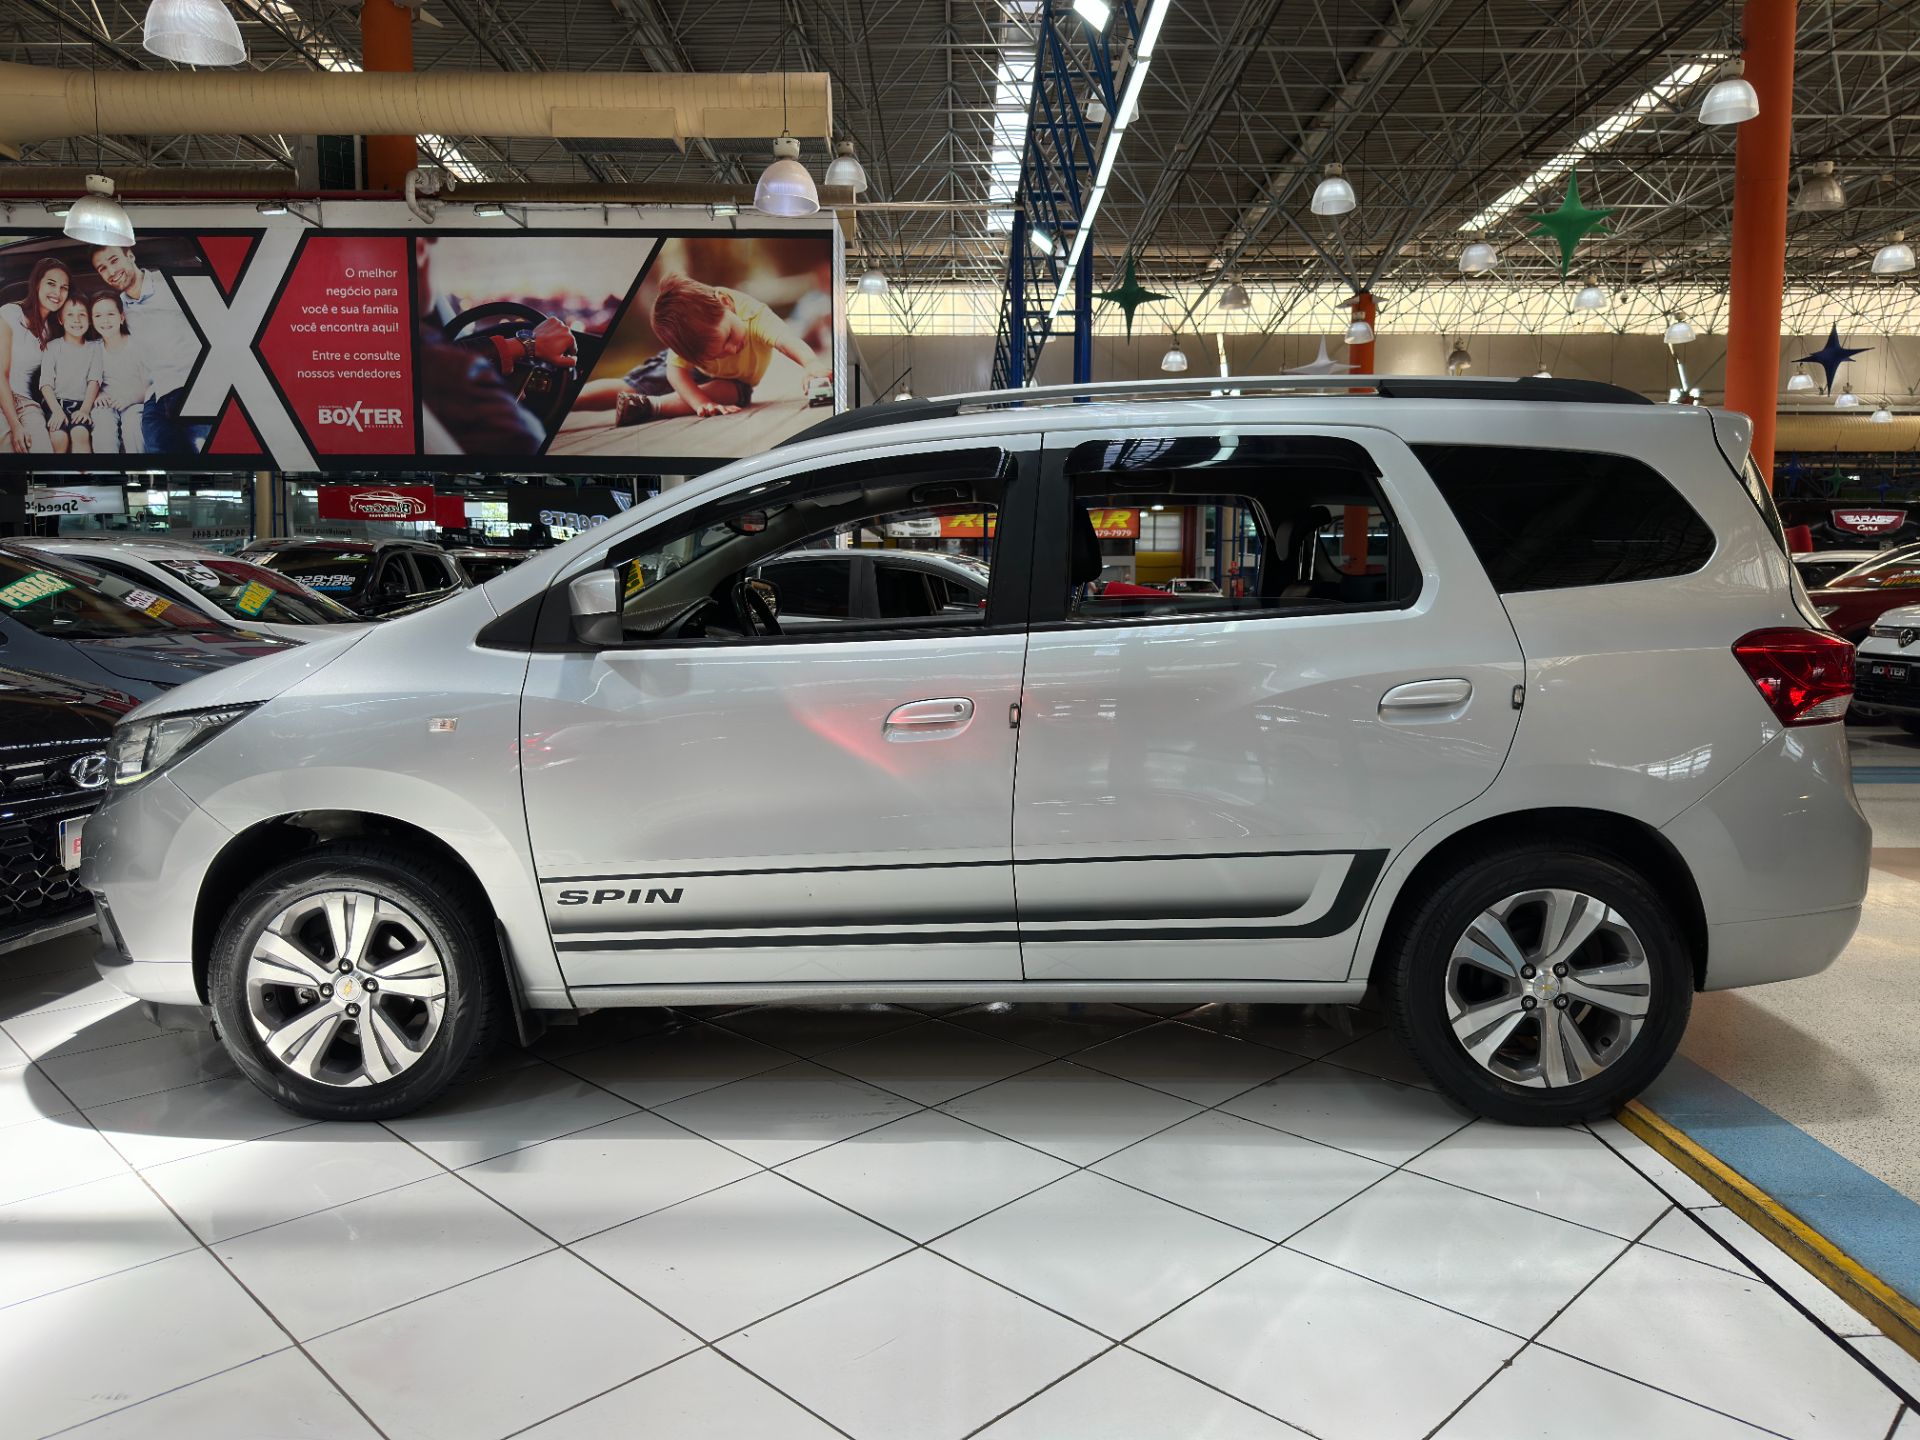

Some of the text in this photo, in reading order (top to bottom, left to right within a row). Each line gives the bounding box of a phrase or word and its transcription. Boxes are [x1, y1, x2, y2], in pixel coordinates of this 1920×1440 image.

[345, 268, 398, 278] O melhor
[326, 286, 398, 298] negócio para
[302, 304, 399, 314] você e sua família
[290, 322, 399, 334] você encontra aqui!
[312, 350, 400, 360] Entre e consulte
[297, 368, 401, 378] nossos vendedores
[318, 401, 403, 432] BOXTER
[557, 888, 684, 906] SPIN
